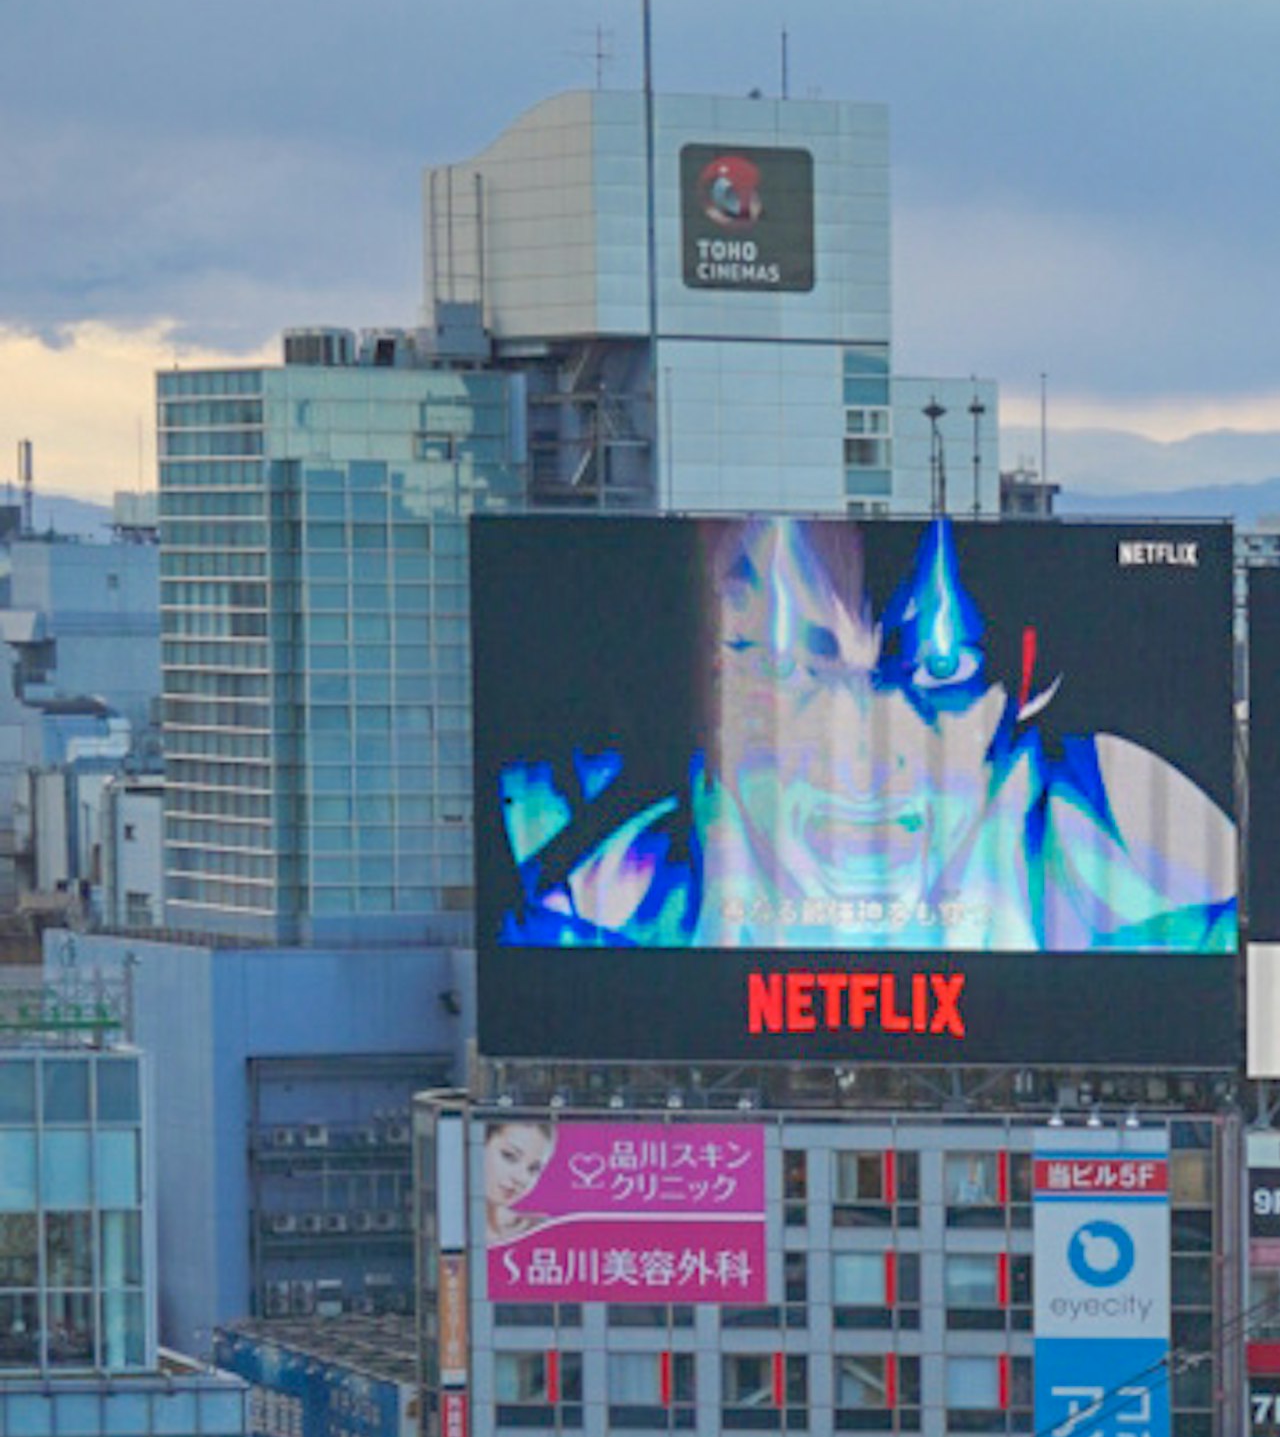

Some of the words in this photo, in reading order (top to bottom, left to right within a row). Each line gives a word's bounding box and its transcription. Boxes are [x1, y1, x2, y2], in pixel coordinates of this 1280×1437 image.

[697, 239, 758, 261] TOHO
[697, 262, 781, 284] CINEMAS
[1117, 541, 1199, 567] NETFLIX
[748, 971, 966, 1039] NETFLIX
[608, 1141, 752, 1171] 品川スキン
[608, 1174, 739, 1203] クリニック
[1048, 1164, 1155, 1189] 当ビル5F
[527, 1247, 752, 1287] 品川美容外科
[1048, 1290, 1155, 1323] eyecity
